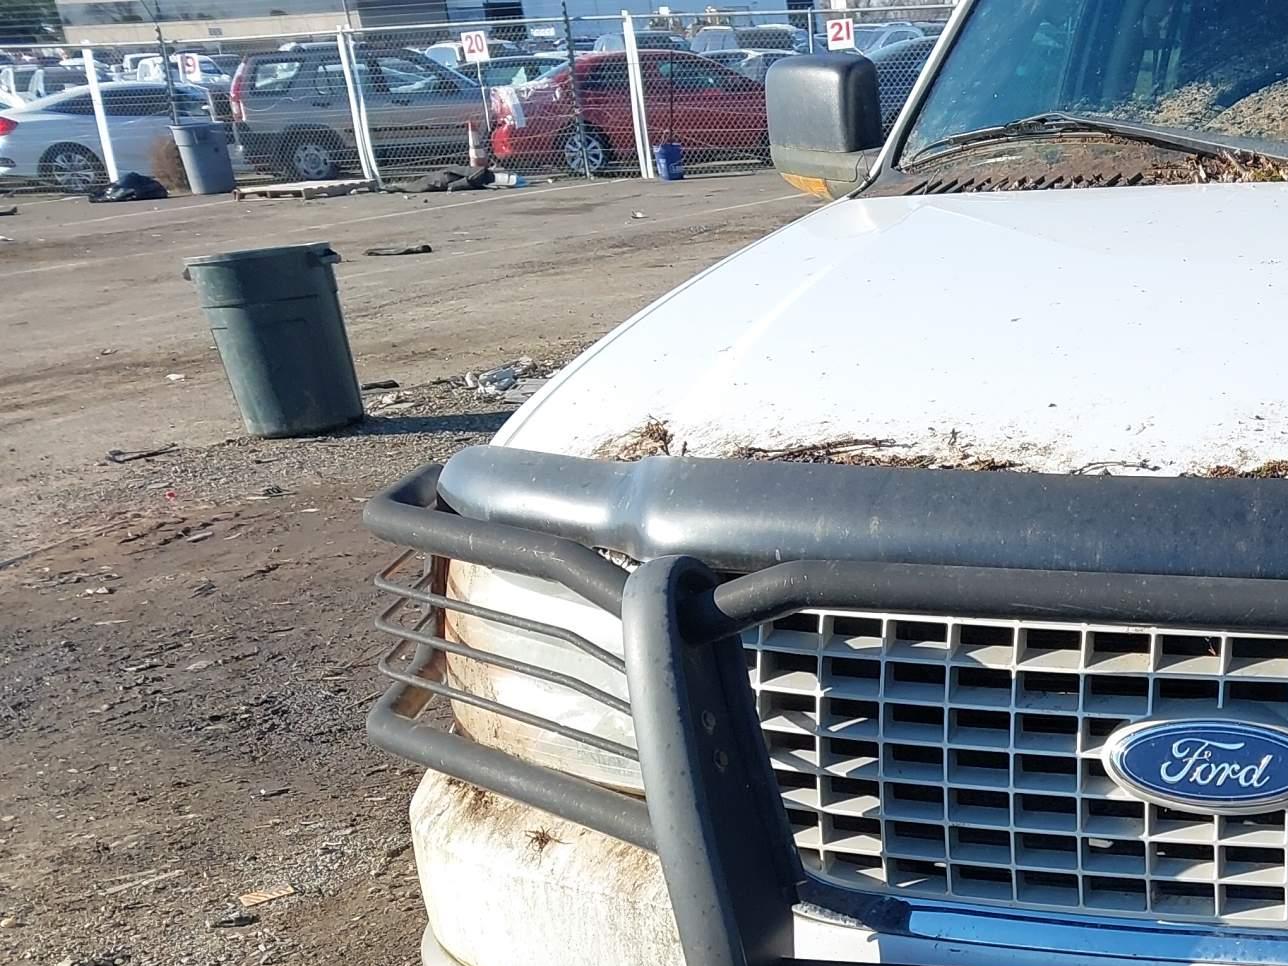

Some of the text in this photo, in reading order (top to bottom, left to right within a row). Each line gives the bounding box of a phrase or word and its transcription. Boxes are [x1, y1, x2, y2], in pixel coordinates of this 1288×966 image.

[831, 21, 851, 42] 21
[465, 34, 484, 53] 20
[1160, 737, 1274, 788] Ford
